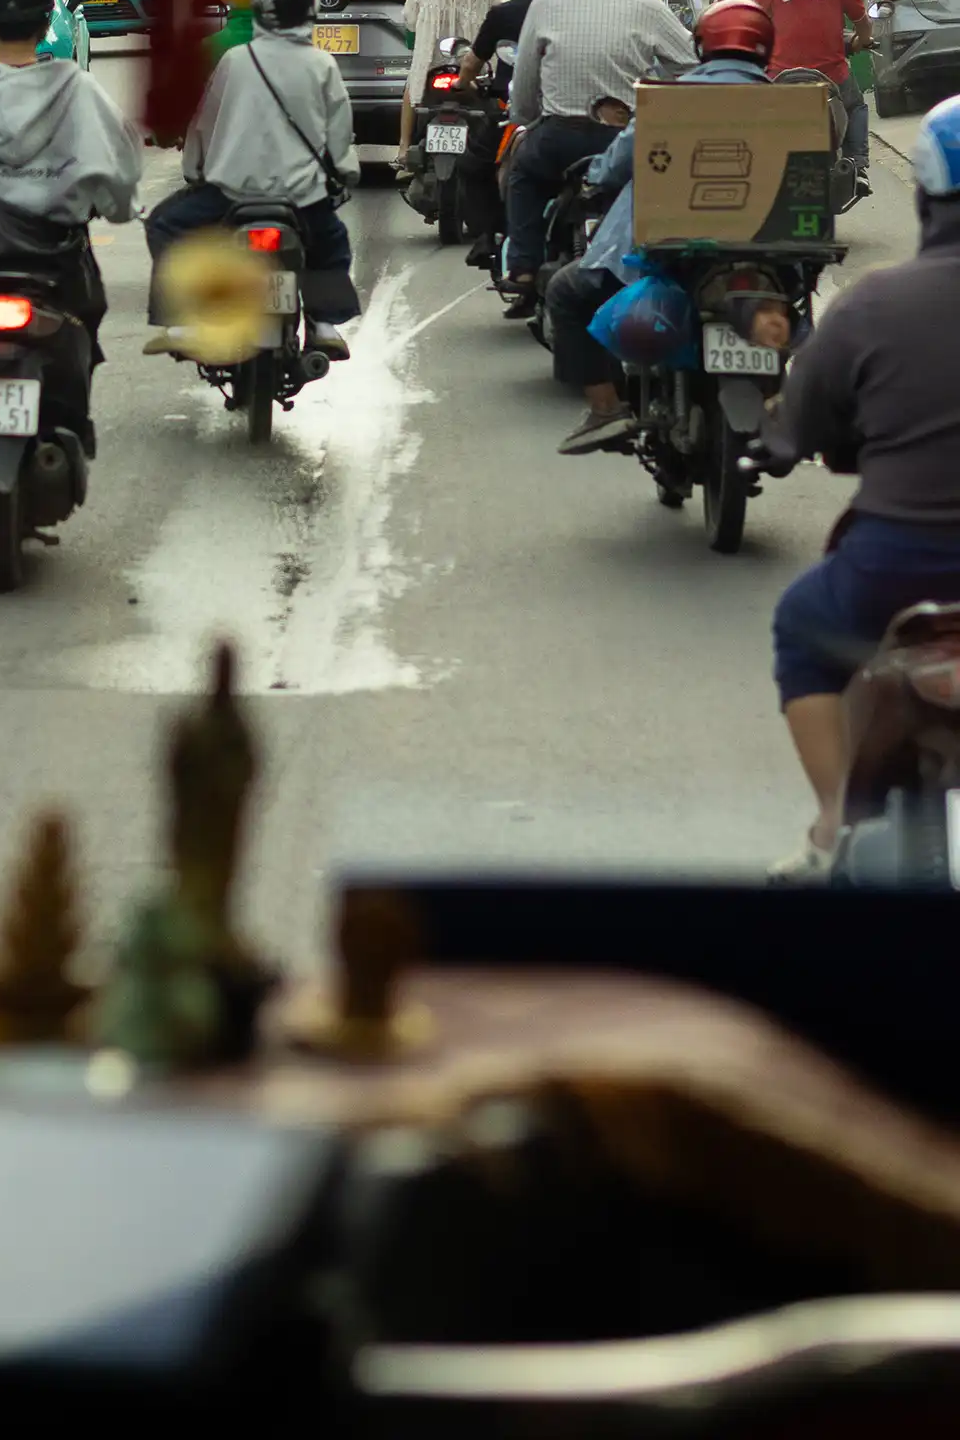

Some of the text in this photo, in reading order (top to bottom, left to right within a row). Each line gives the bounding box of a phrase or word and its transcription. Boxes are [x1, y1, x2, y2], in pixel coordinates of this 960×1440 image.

[433, 127, 461, 139] 72-C2
[428, 139, 464, 152] 616.58
[710, 348, 775, 371] 283.00
